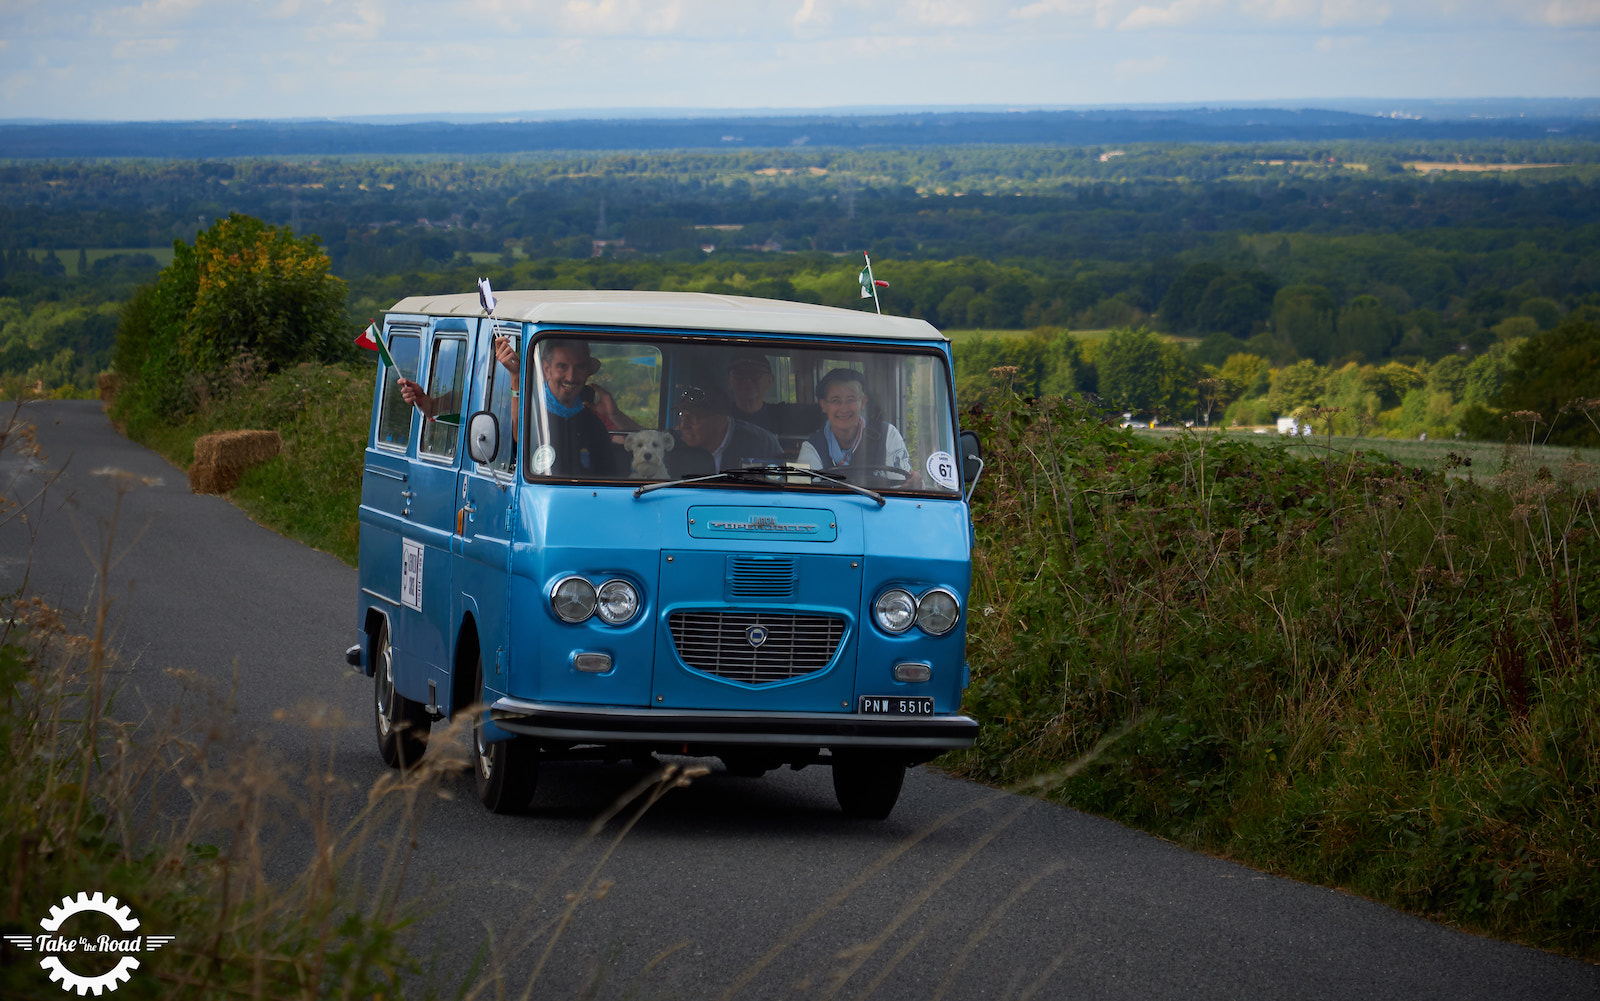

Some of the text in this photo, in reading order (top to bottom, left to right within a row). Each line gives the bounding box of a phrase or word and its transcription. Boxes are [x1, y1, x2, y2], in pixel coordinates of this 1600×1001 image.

[939, 463, 952, 478] 67
[864, 699, 931, 714] PNW 551C
